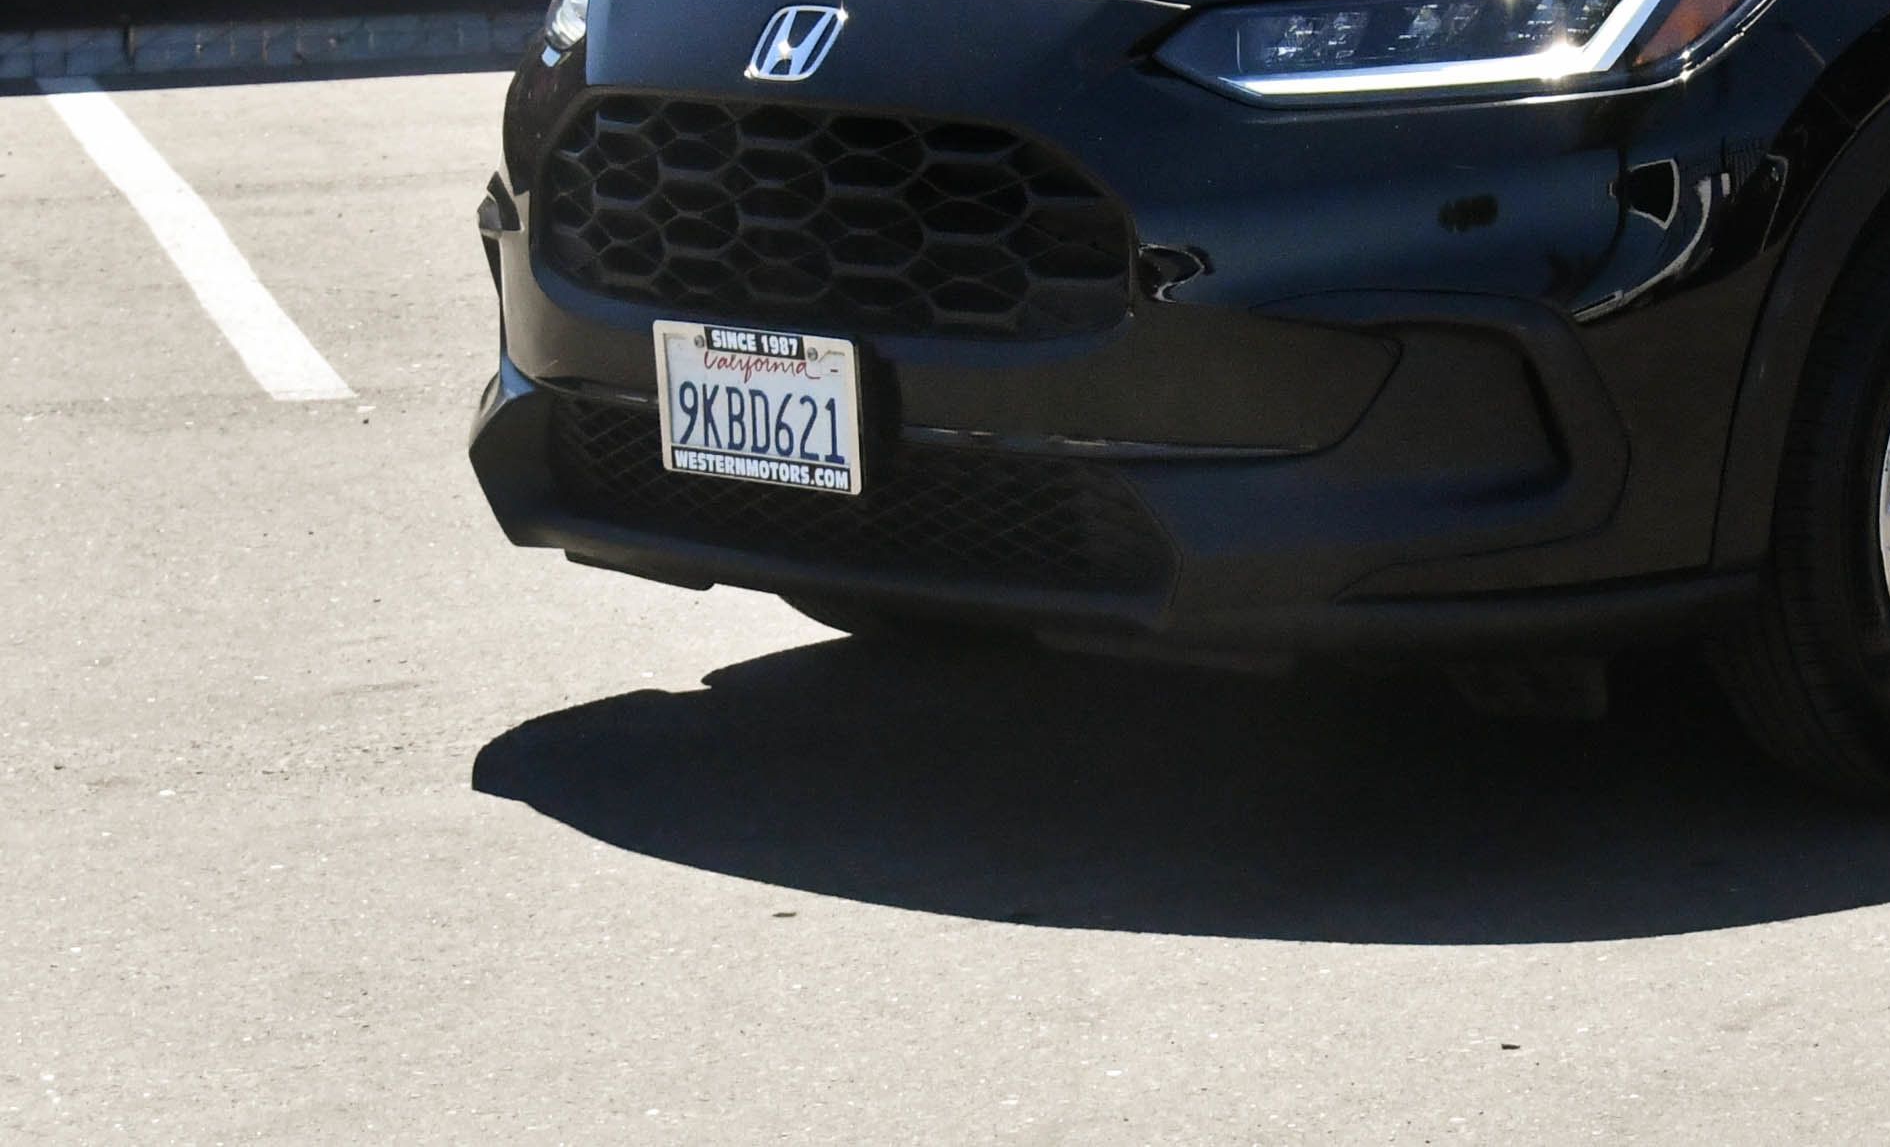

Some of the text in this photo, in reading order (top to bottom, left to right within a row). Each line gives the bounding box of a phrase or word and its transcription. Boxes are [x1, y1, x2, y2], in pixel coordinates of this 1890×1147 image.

[711, 329, 799, 357] SINCE 1987
[704, 351, 821, 384] California
[678, 380, 846, 465] 9KBD621
[674, 449, 850, 490] WESTERNMOTORS.COM
